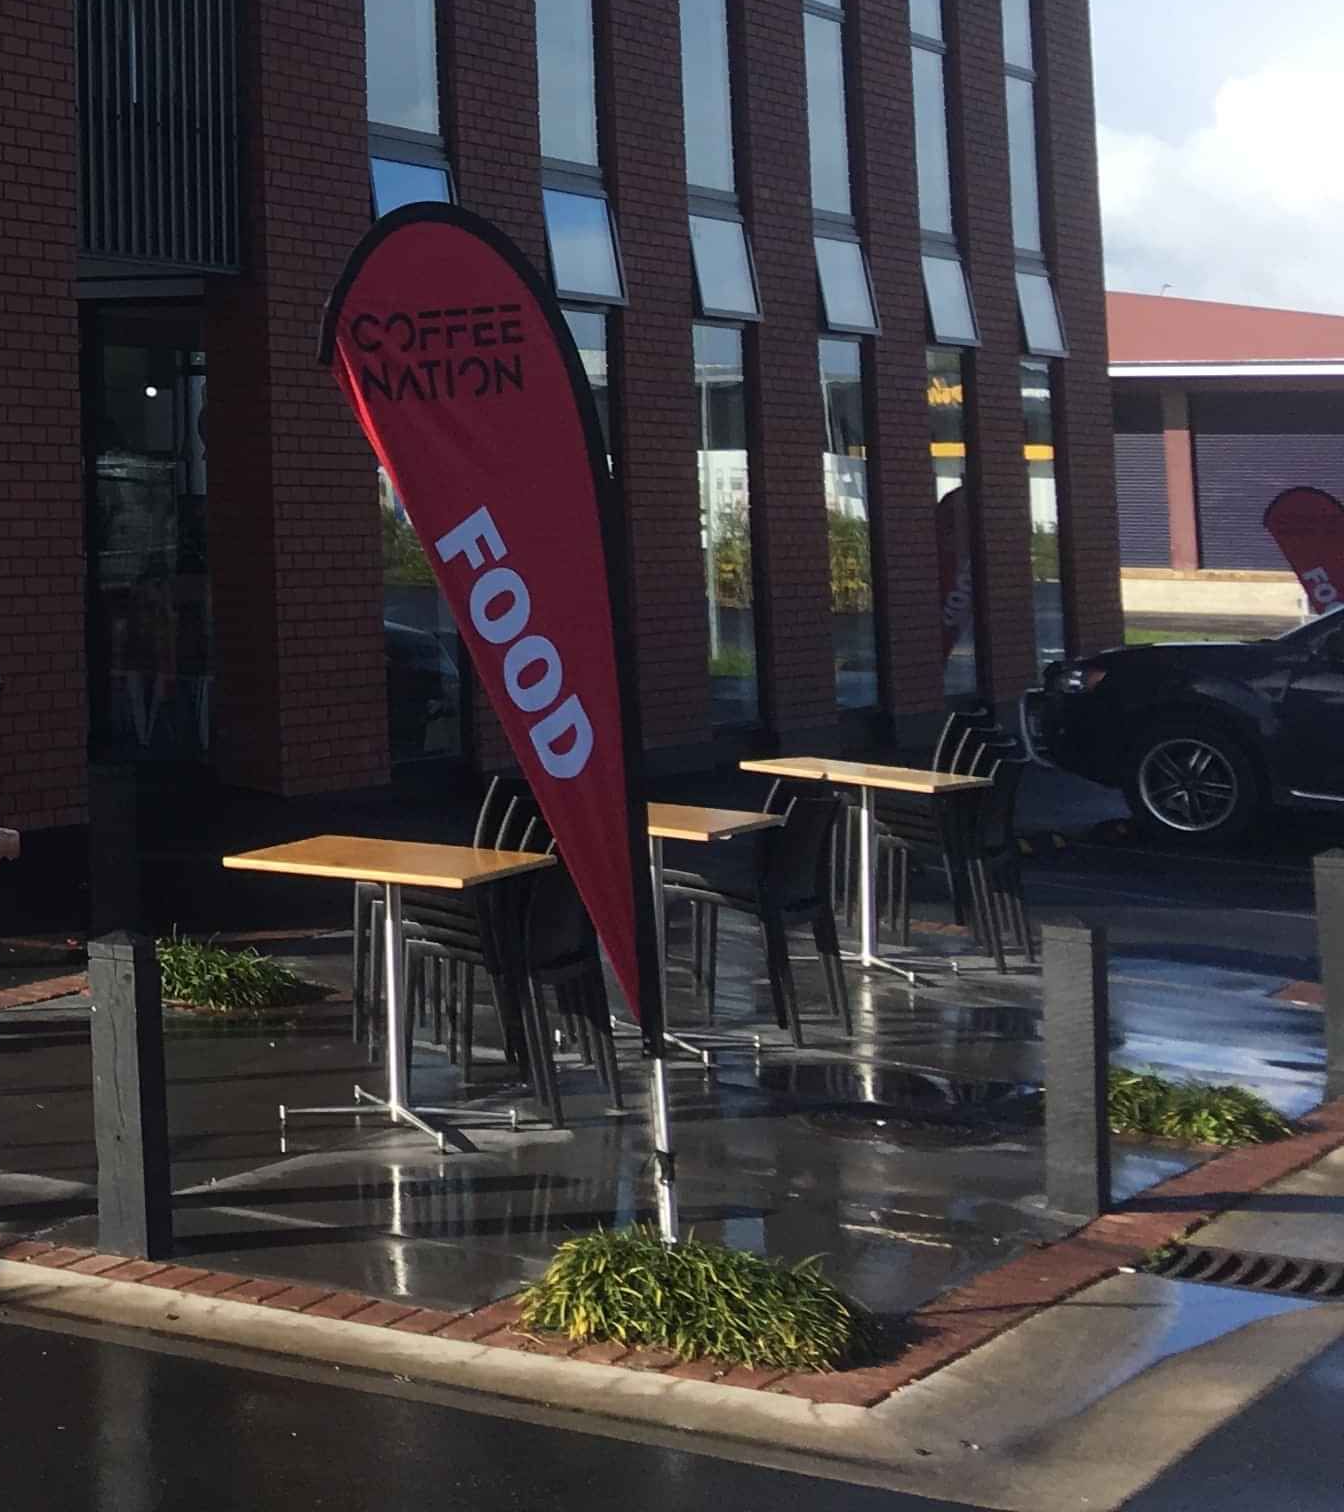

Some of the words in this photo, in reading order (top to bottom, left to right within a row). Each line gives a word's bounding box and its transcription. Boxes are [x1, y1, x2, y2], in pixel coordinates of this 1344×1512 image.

[351, 304, 526, 353] COFFEE
[362, 354, 524, 402] NATION
[434, 505, 594, 779] FOOD
